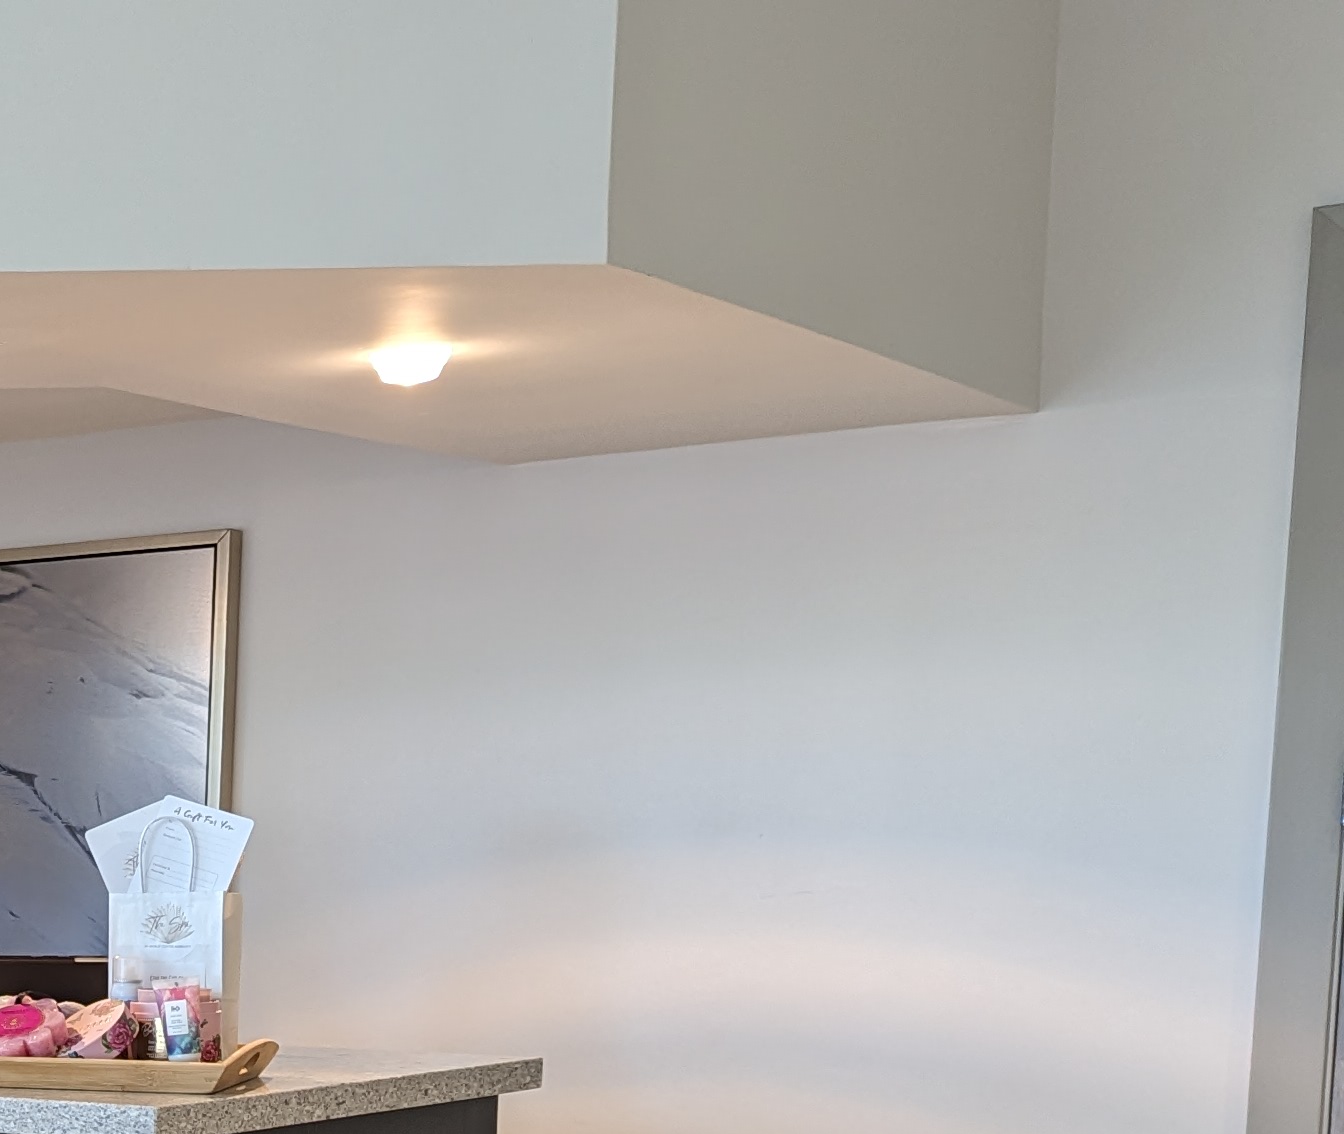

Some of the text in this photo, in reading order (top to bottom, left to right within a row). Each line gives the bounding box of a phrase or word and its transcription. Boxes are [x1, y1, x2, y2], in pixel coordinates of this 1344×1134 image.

[173, 806, 182, 815] A
[203, 815, 218, 827] For
[220, 820, 235, 831] You
